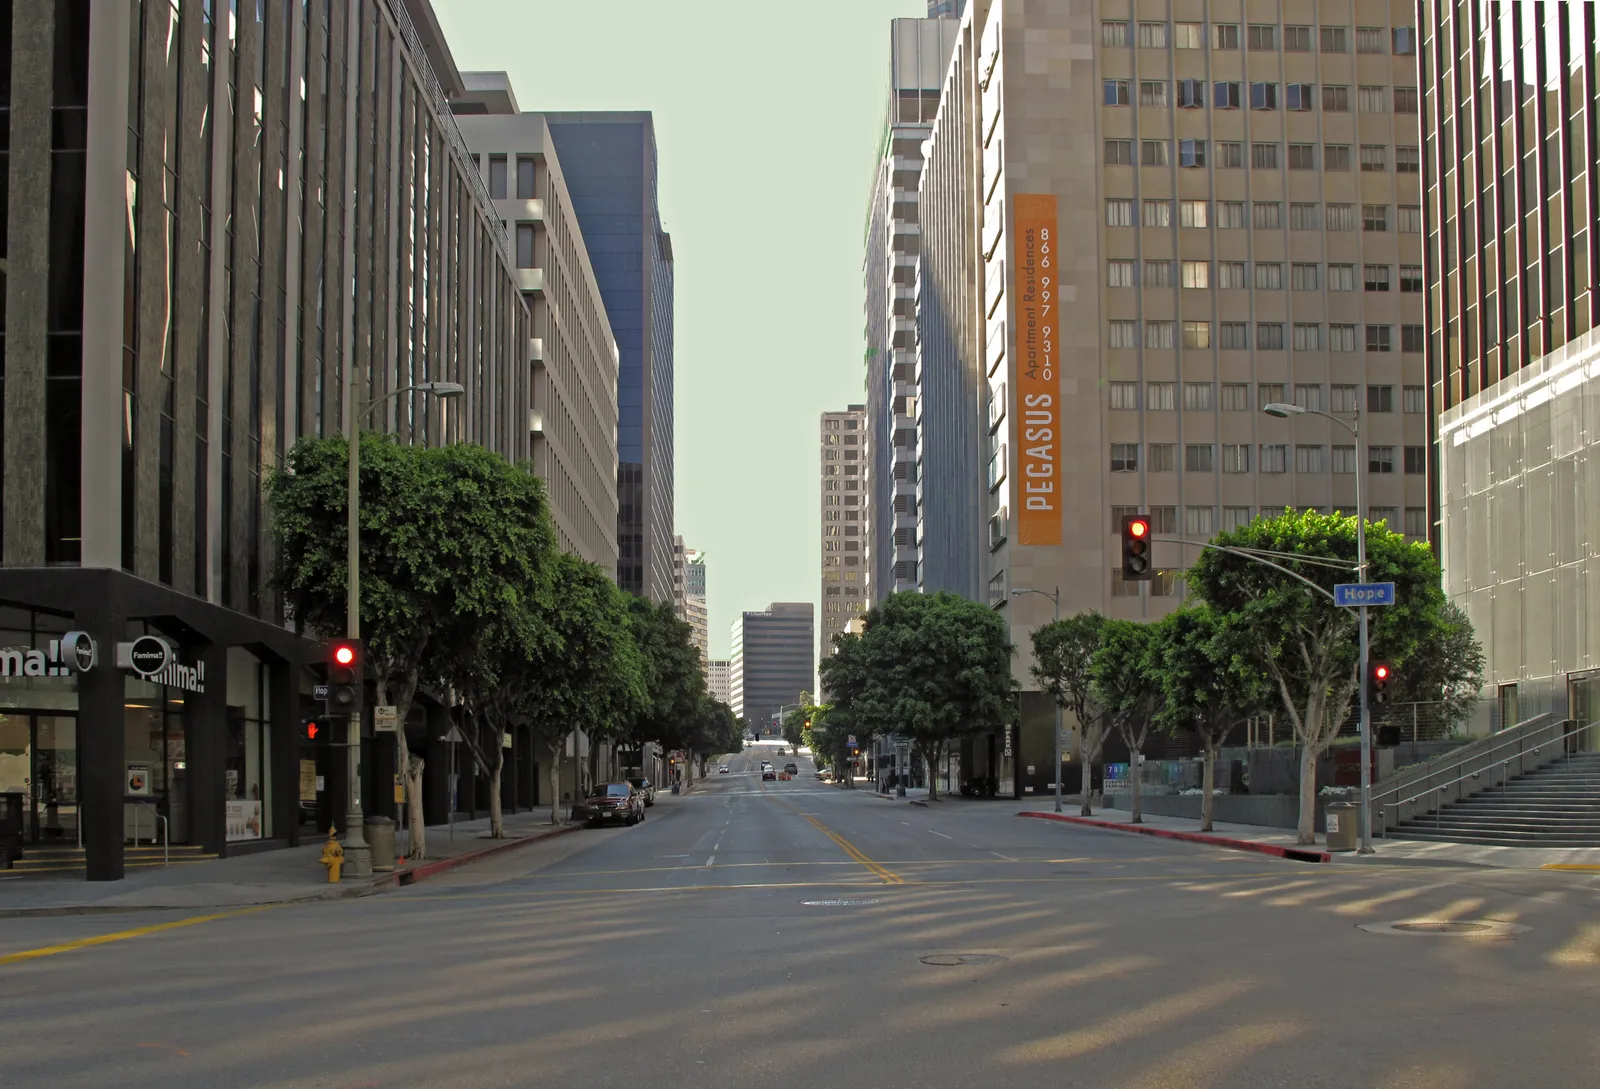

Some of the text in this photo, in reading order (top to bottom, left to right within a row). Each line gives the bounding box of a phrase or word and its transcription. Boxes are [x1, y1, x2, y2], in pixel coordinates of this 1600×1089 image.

[1023, 228, 1040, 380] Apartment Residences
[1025, 393, 1053, 510] PEGASUS
[1344, 587, 1385, 600] Hope
[133, 651, 163, 659] Famima!!
[315, 686, 328, 696] Hop
